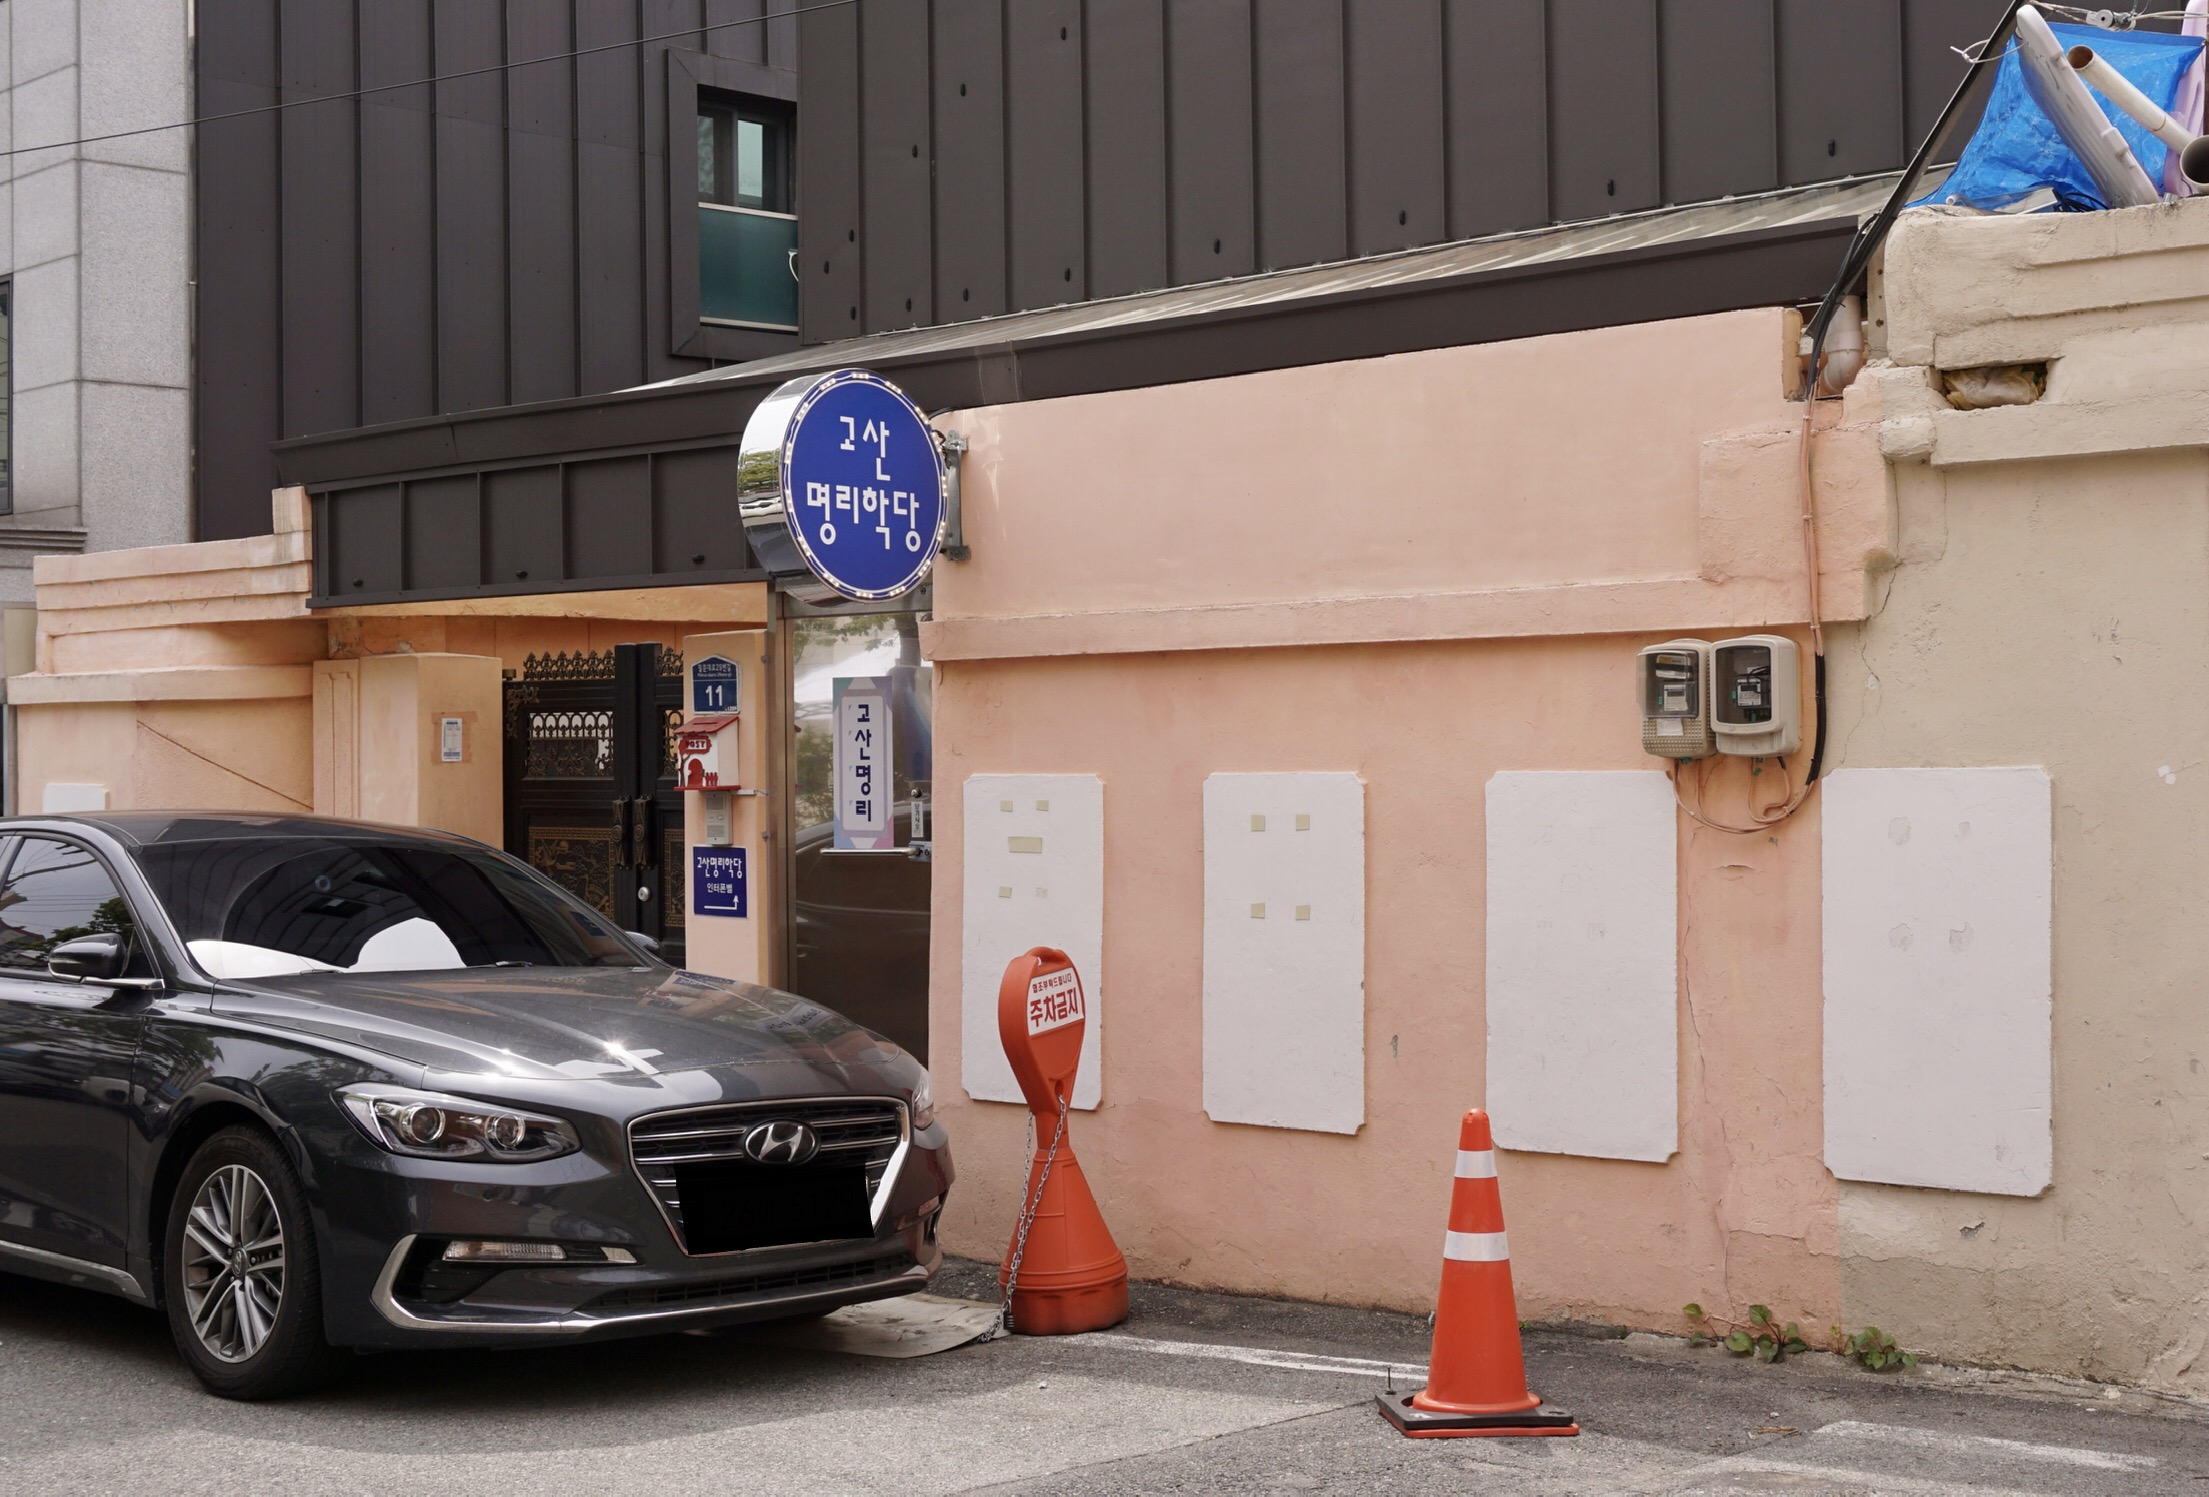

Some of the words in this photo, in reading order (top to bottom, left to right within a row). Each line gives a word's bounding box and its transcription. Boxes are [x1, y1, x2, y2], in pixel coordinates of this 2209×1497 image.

[840, 415, 891, 481] 고산
[806, 481, 921, 552] 명리학당
[705, 685, 722, 706] 11
[685, 740, 705, 748] POST
[855, 704, 872, 822] 고산명리
[697, 857, 743, 879] 고산명리학당
[706, 883, 733, 894] 인터폰벨
[1030, 987, 1078, 1027] 주차금지
